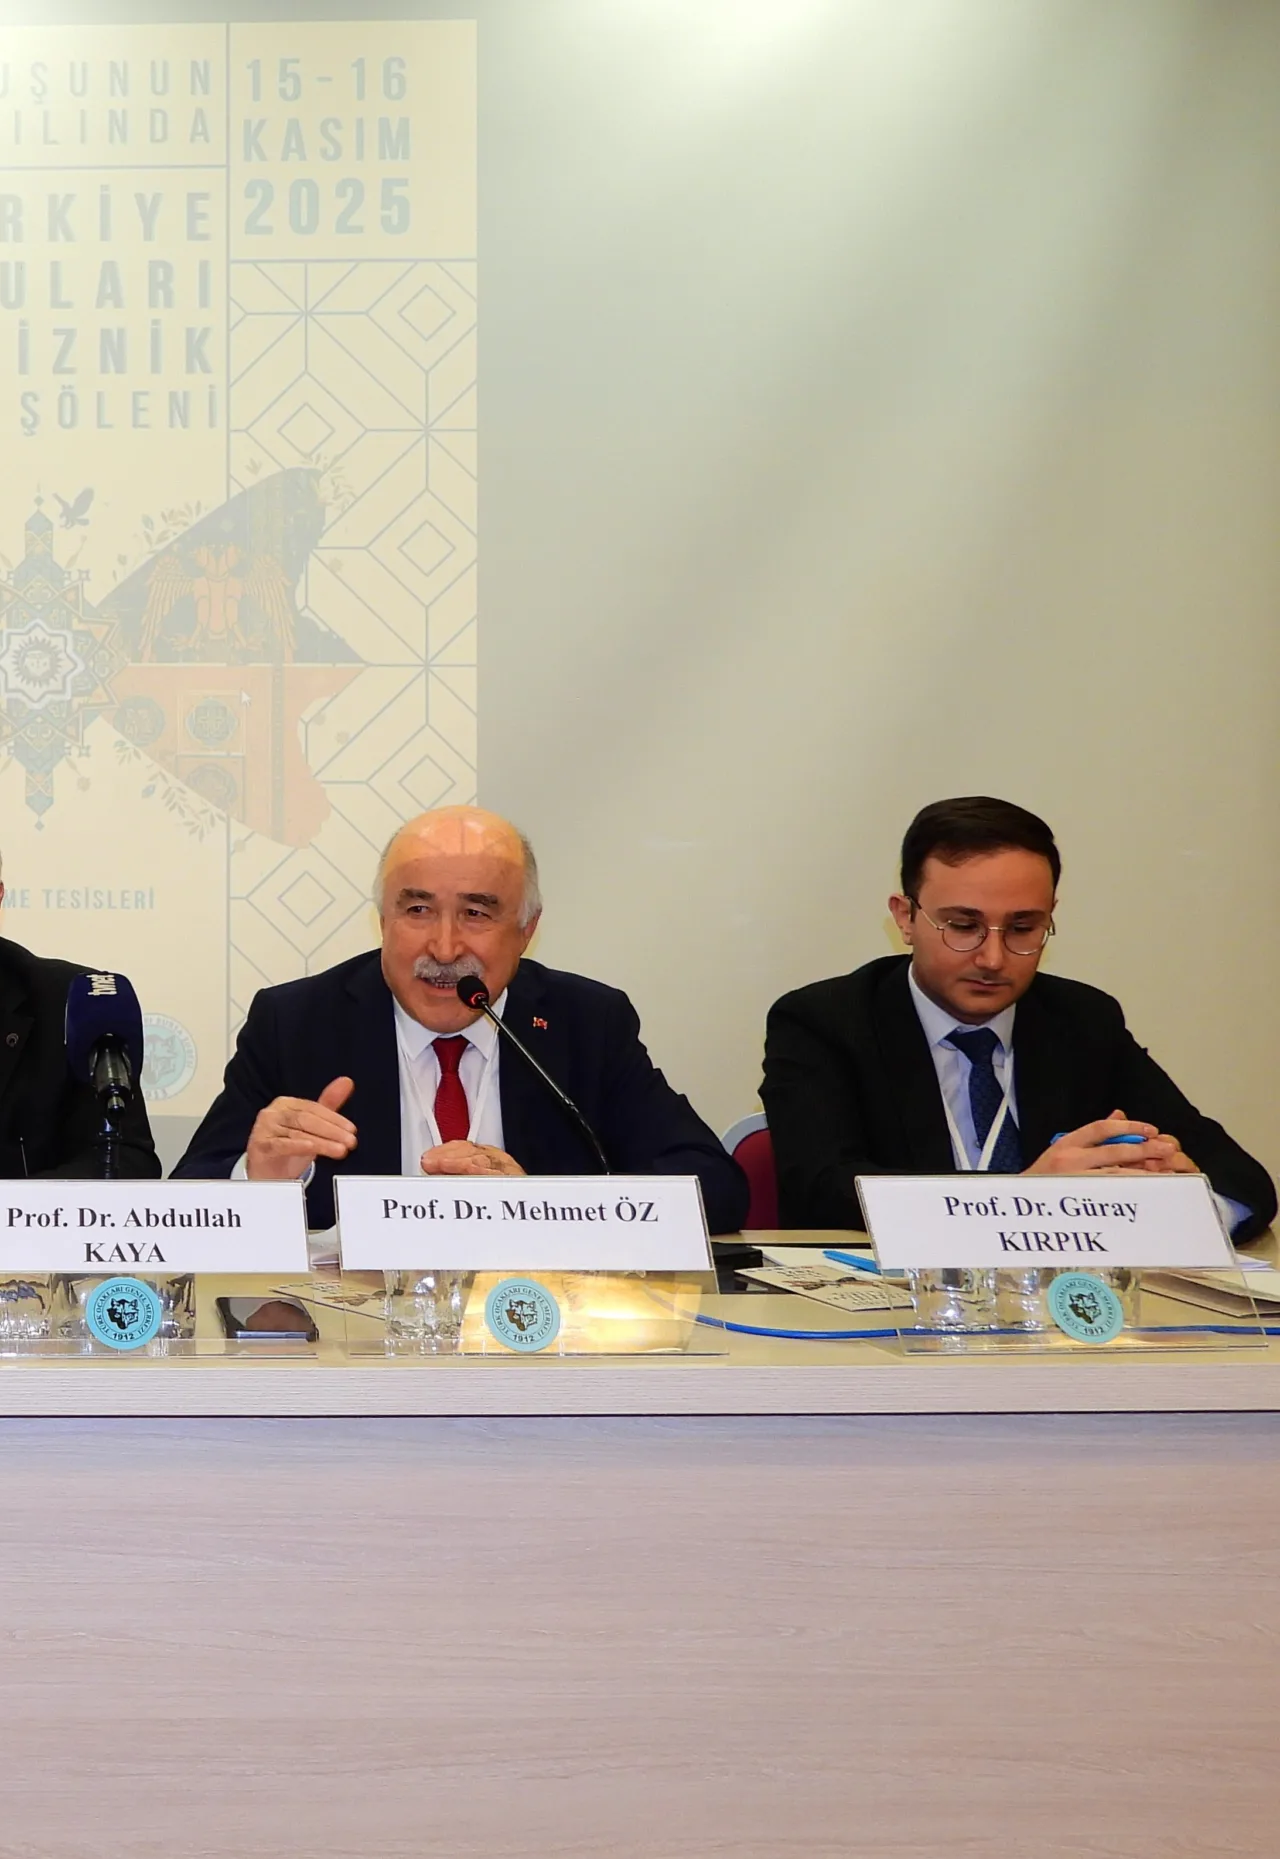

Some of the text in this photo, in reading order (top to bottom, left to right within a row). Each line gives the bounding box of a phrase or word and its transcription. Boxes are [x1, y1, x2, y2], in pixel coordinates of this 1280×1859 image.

[247, 57, 406, 102] 15-16
[244, 117, 410, 162] KASIM
[244, 178, 409, 235] 2025
[18, 319, 213, 375] İZNİK
[20, 384, 216, 436] ŞÖLENİ
[42, 887, 153, 909] TESİSLERİ
[8, 1208, 241, 1227] Prof. Dr. Abdullah
[382, 1197, 658, 1222] Prof. Dr. Mehmet ÖZ
[944, 1197, 1137, 1222] Prof. Dr. Güray
[84, 1243, 166, 1262] KAYA
[997, 1232, 1108, 1251] KIRPIK
[96, 1286, 123, 1313] OCAKLARI
[125, 1286, 147, 1303] GENEL
[495, 1287, 521, 1314] OCAKLARI
[96, 1315, 110, 1333] TÜRK
[1084, 1327, 1105, 1335] 1912
[112, 1332, 135, 1340] 1912
[513, 1334, 535, 1342] 1912
